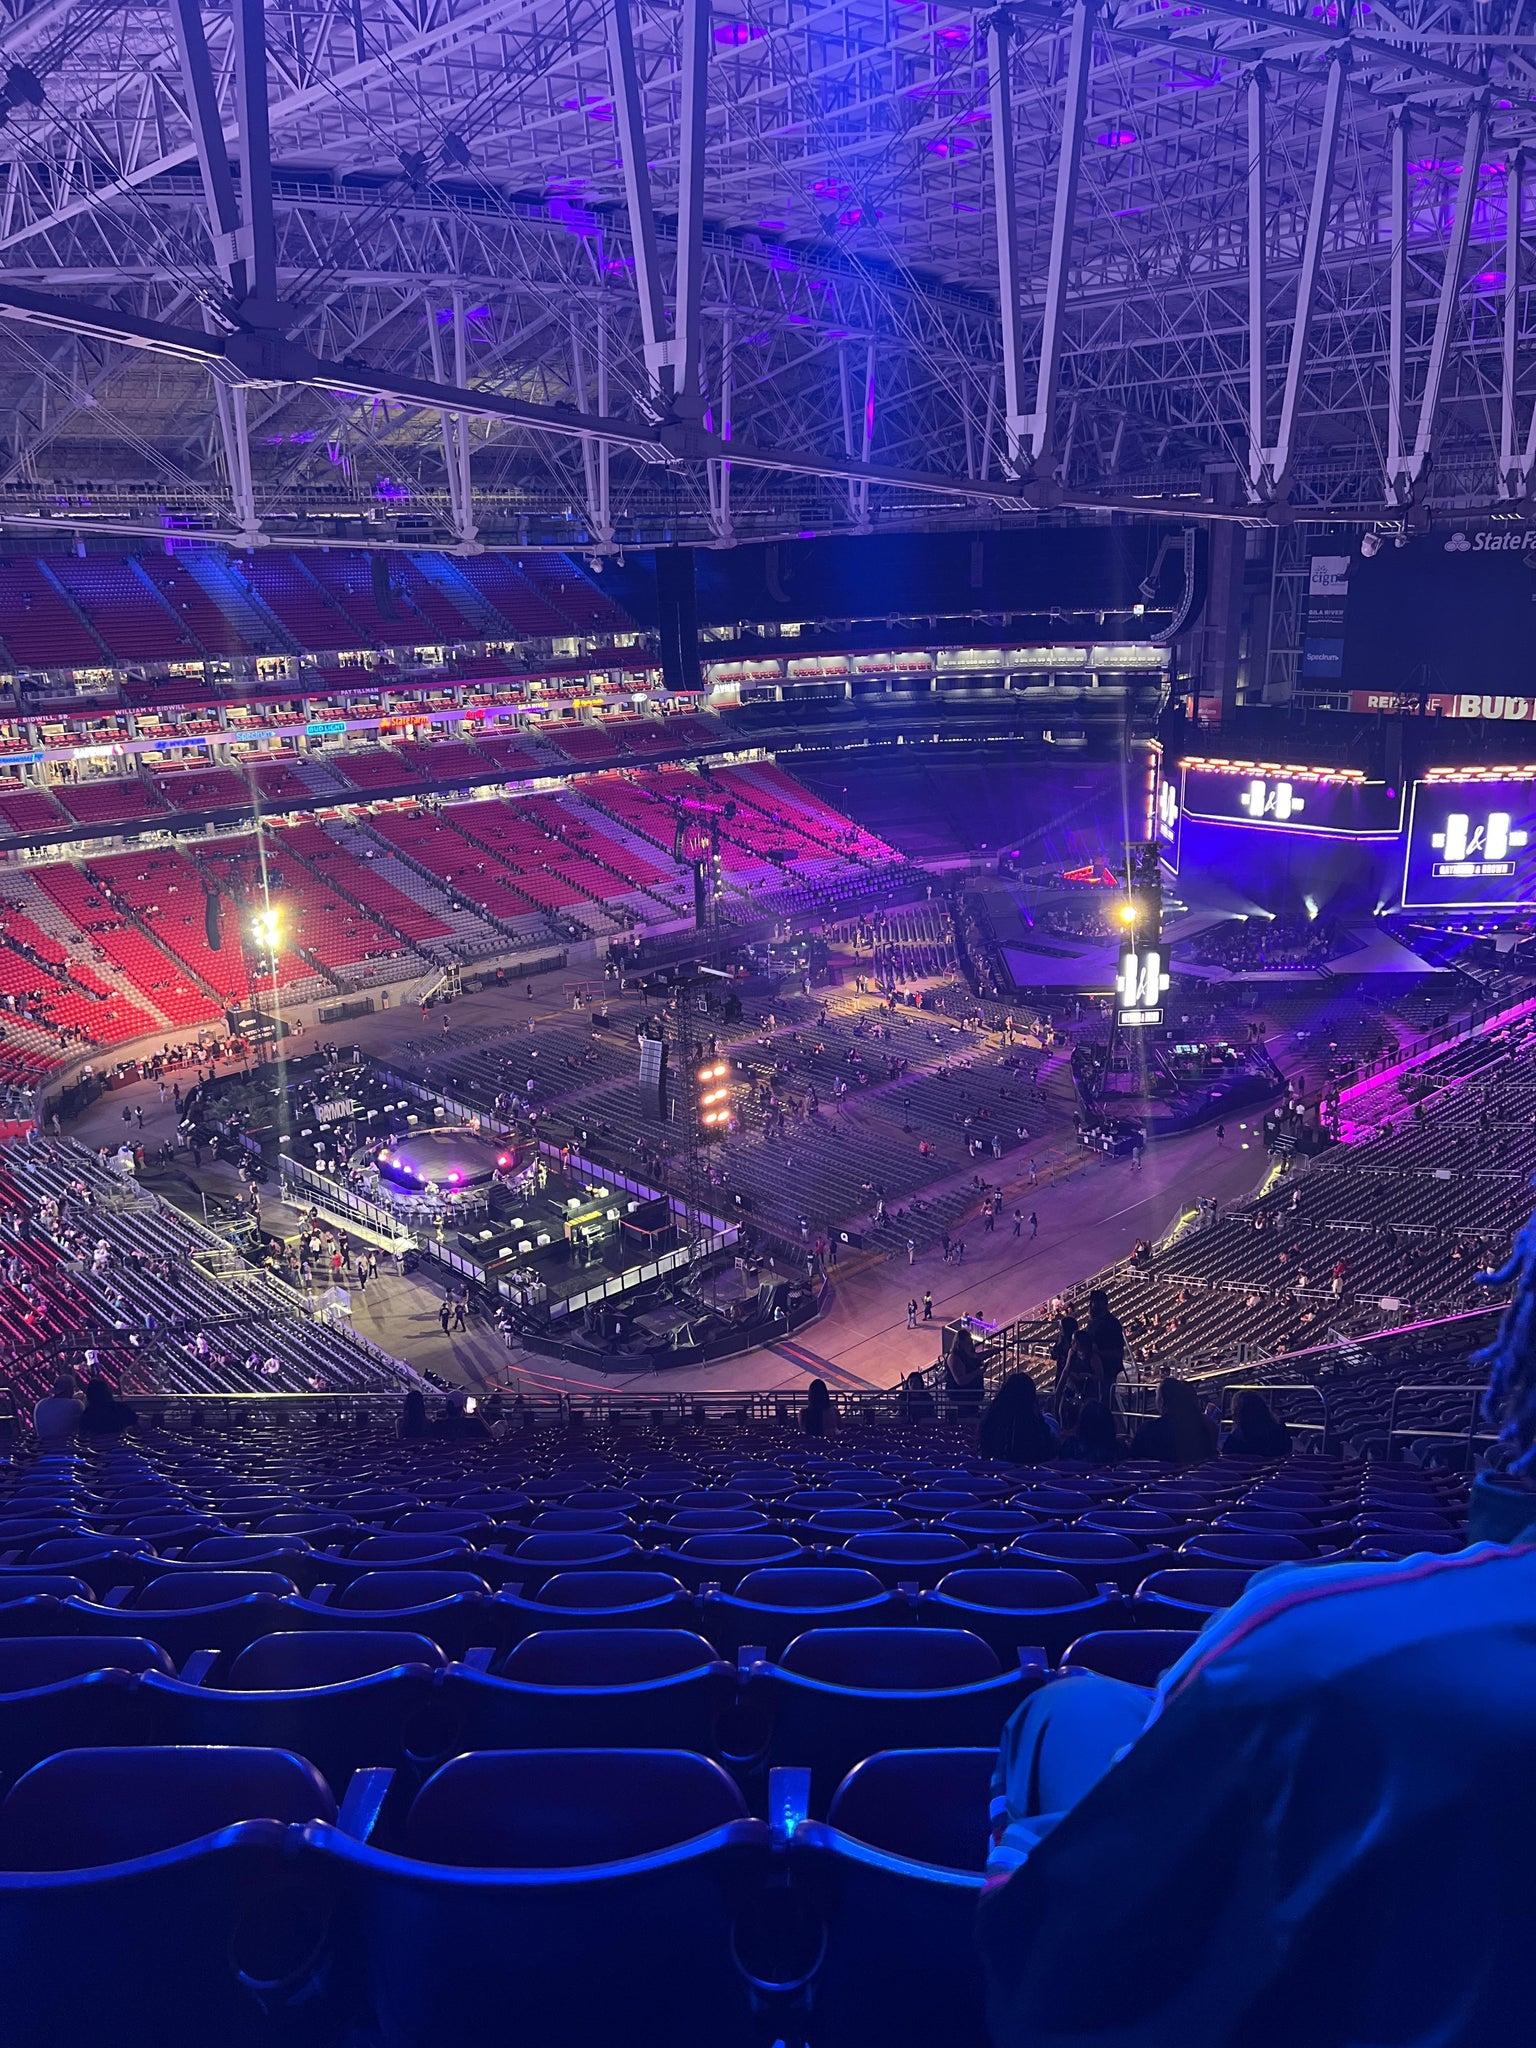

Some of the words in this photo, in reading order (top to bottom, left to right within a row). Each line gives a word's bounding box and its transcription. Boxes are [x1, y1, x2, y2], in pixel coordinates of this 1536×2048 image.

[1306, 653, 1336, 661] Spectrum
[1460, 694, 1528, 720] BUD
[236, 730, 272, 741] Spectrum
[1166, 1031, 1173, 1039] E
[736, 1061, 743, 1070] N
[318, 1098, 354, 1123] RAYMOND
[975, 1139, 983, 1149] M
[735, 1195, 742, 1205] R
[840, 1232, 849, 1243] Q
